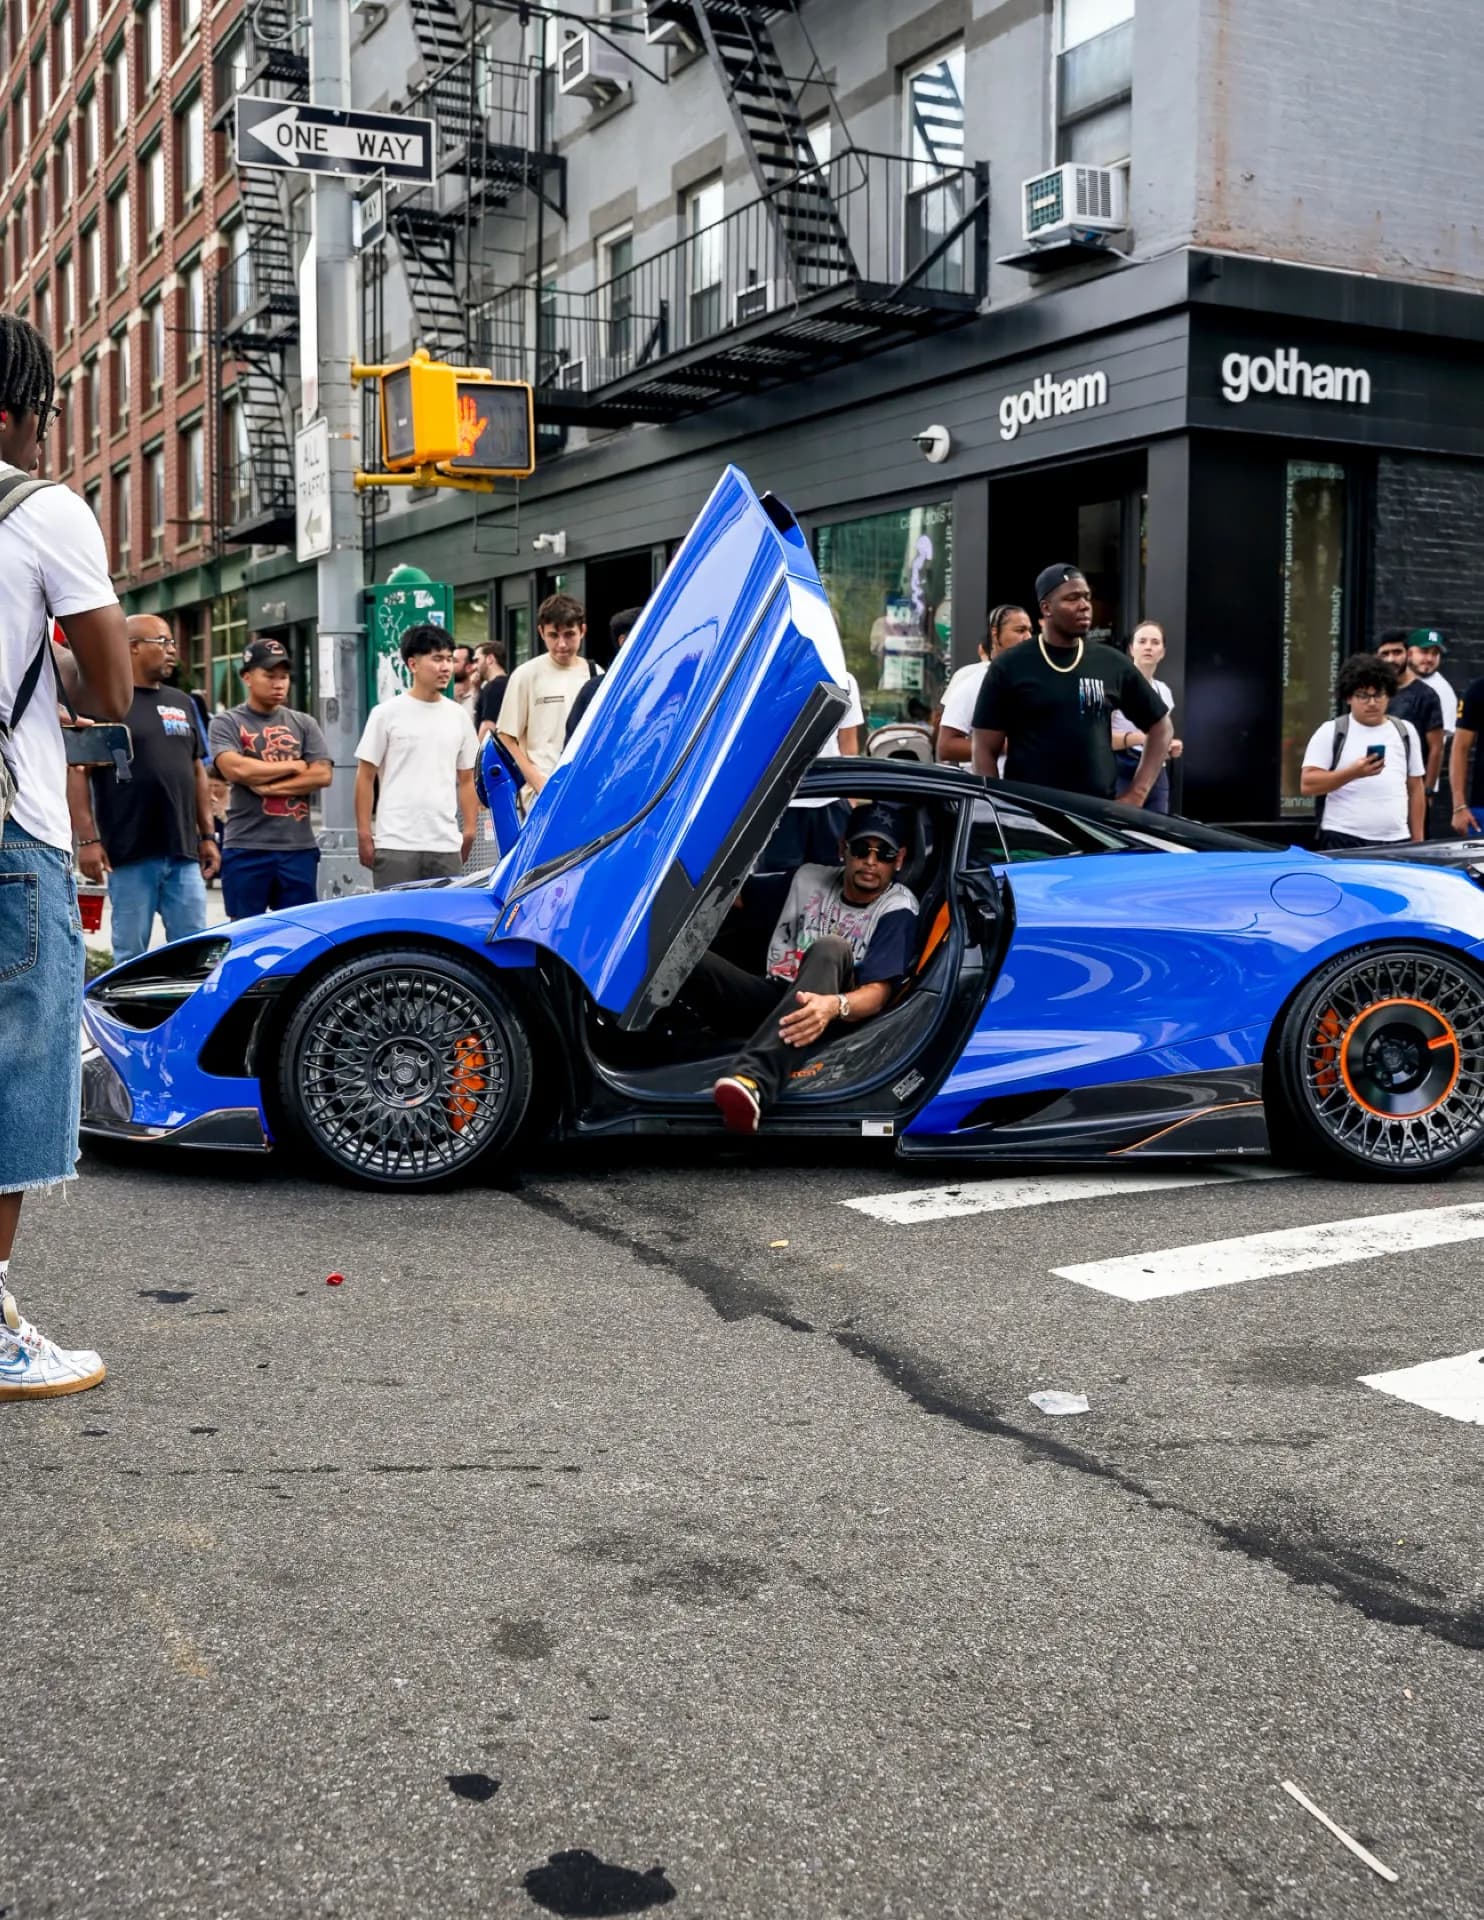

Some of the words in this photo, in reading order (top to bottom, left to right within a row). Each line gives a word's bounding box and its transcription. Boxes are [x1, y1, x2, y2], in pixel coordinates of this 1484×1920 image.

[277, 123, 329, 152] ONE
[357, 132, 411, 161] WAY
[1221, 347, 1371, 403] gotham
[999, 370, 1107, 440] gotham
[1328, 585, 1343, 635] beauty
